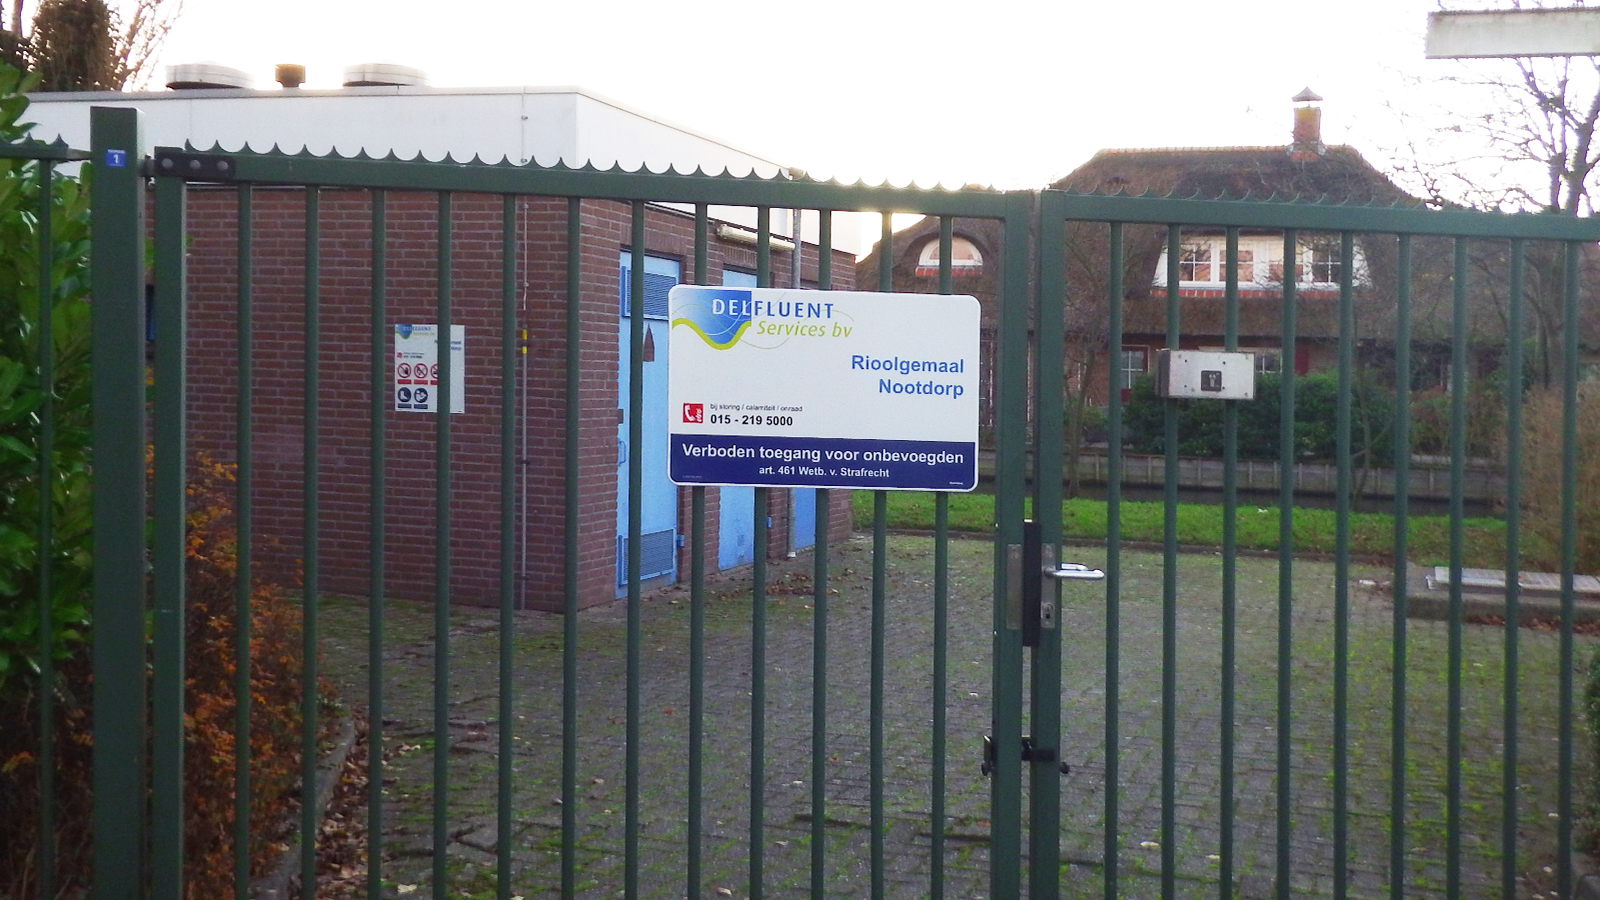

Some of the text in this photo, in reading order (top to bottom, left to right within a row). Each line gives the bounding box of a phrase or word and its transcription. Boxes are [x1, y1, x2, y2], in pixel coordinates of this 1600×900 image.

[113, 154, 119, 164] 1
[711, 298, 834, 319] DELFLUENT
[757, 320, 853, 338] Services bv
[851, 355, 964, 375] Rioolgemaal
[878, 379, 964, 399] Nootdorp
[710, 414, 731, 424] 015
[742, 415, 763, 425] 219
[766, 415, 793, 426] 5000
[682, 443, 964, 465] Verboden toegang voor onbevoegden
[759, 466, 775, 475] art.
[778, 466, 795, 475] 461
[798, 466, 827, 476] Wetb.
[840, 467, 890, 478] Strafrecht
